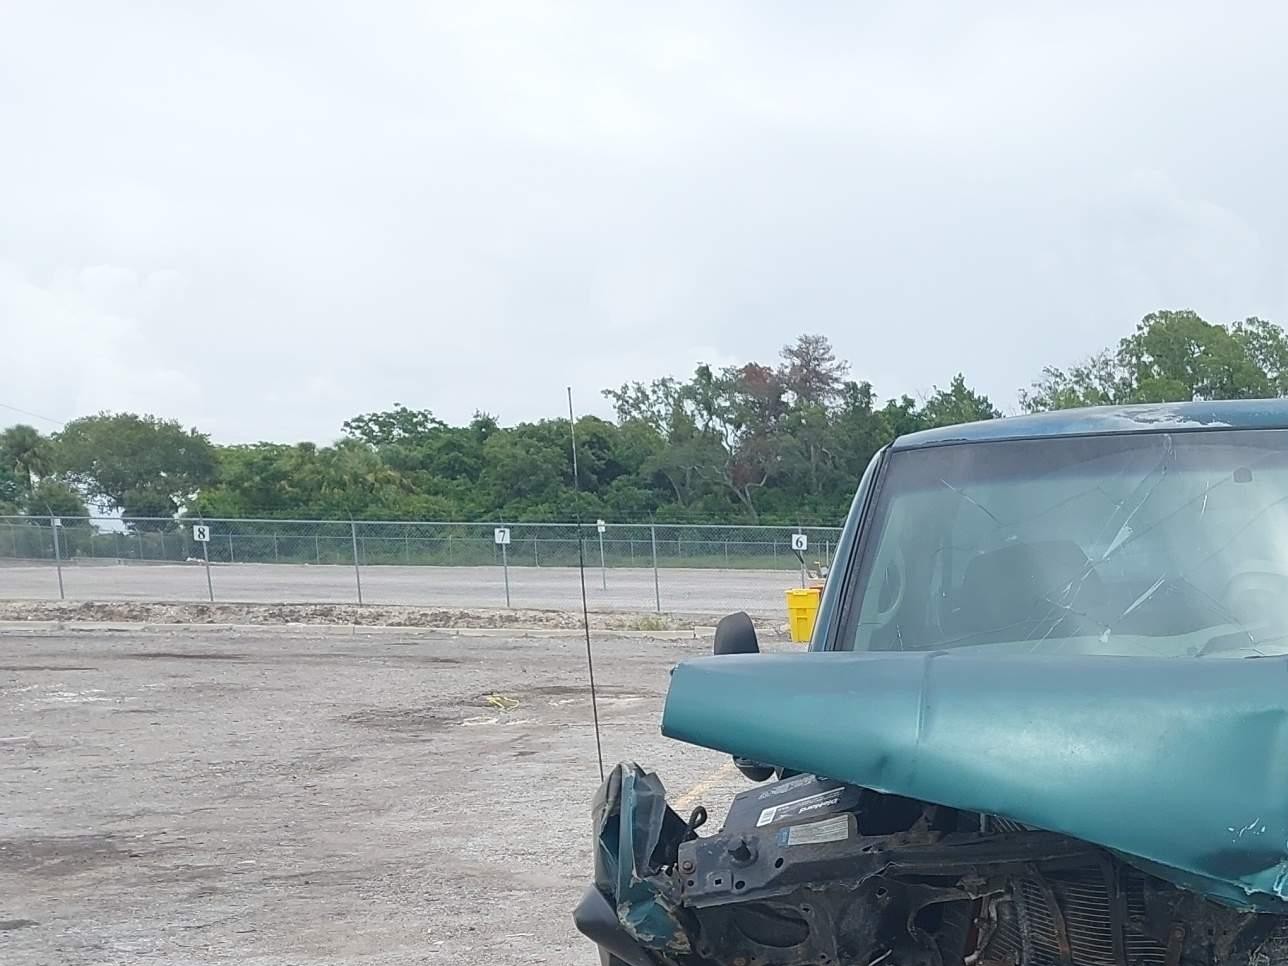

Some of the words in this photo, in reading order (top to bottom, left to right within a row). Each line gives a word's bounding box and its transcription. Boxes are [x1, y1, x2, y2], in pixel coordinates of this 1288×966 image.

[197, 526, 206, 540] 8
[499, 529, 506, 542] 7
[795, 536, 804, 549] 6
